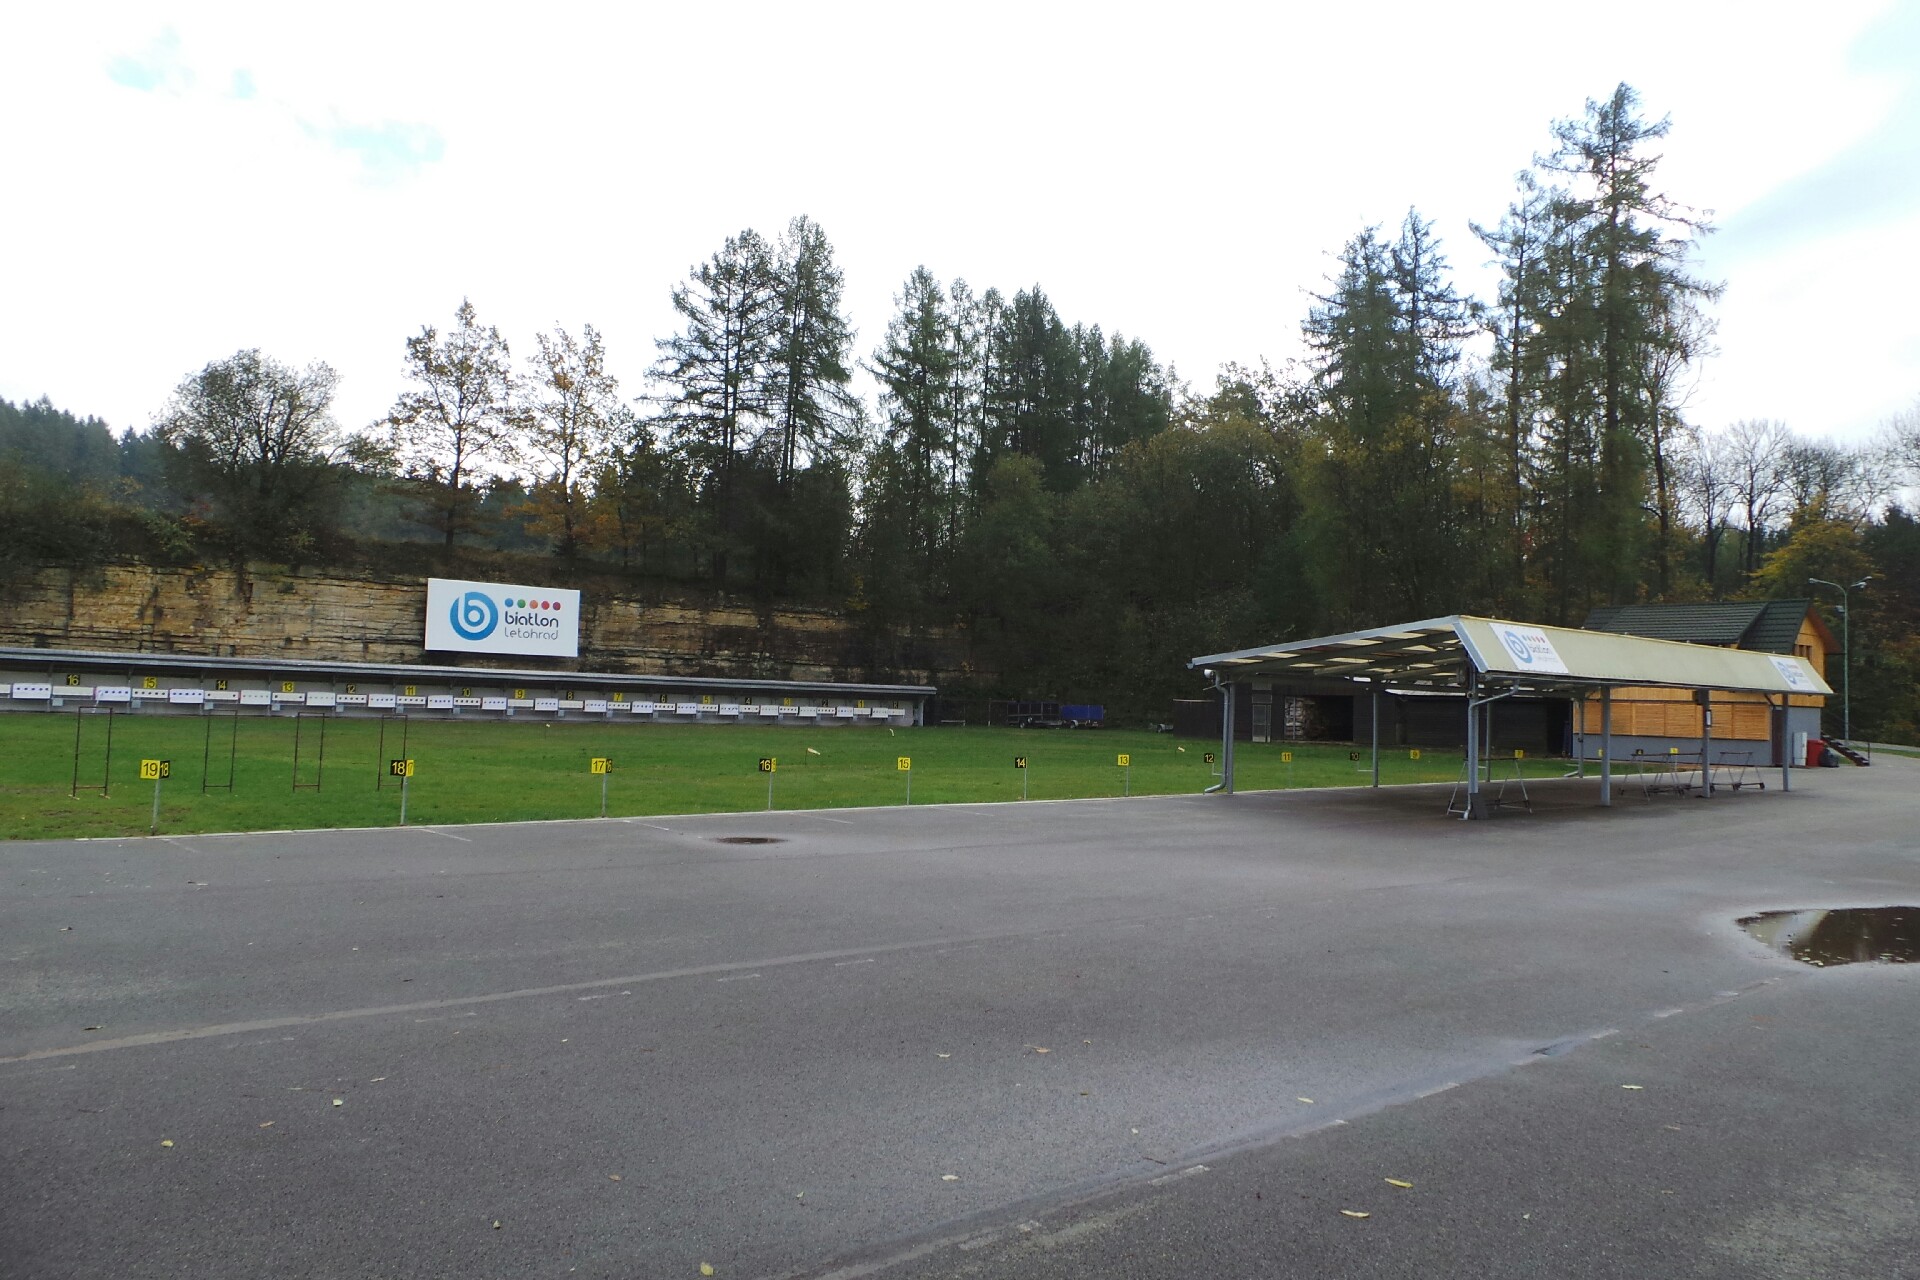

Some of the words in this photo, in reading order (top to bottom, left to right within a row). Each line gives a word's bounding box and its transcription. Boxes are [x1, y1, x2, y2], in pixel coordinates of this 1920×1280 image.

[504, 611, 559, 628] biatlon
[504, 627, 559, 640] letohrad
[68, 674, 80, 686] 16
[144, 677, 156, 688] 15
[216, 680, 227, 690] 14
[346, 684, 356, 694] 12
[462, 688, 470, 697] 10
[1016, 758, 1026, 768] 14
[1119, 756, 1128, 765] 13
[1204, 754, 1214, 762] 12
[392, 760, 405, 775] 18
[593, 761, 605, 771] 17
[760, 760, 771, 770] 16
[899, 759, 910, 768] 15
[143, 762, 158, 776] 19
[160, 762, 169, 777] 18
